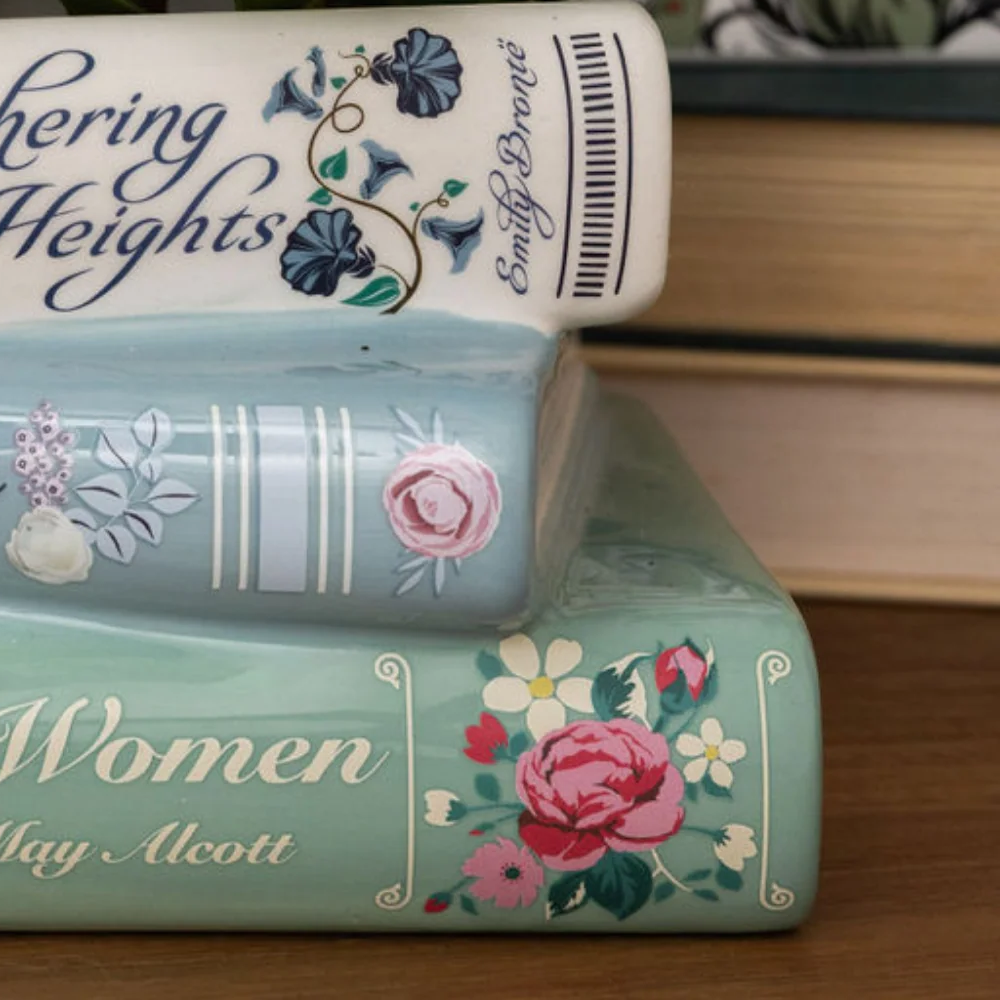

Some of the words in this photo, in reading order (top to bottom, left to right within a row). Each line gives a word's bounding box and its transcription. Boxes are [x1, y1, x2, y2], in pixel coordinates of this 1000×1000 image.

[496, 37, 538, 178] Brontë
[488, 170, 555, 296] Emily
[101, 821, 299, 866] Alcott
